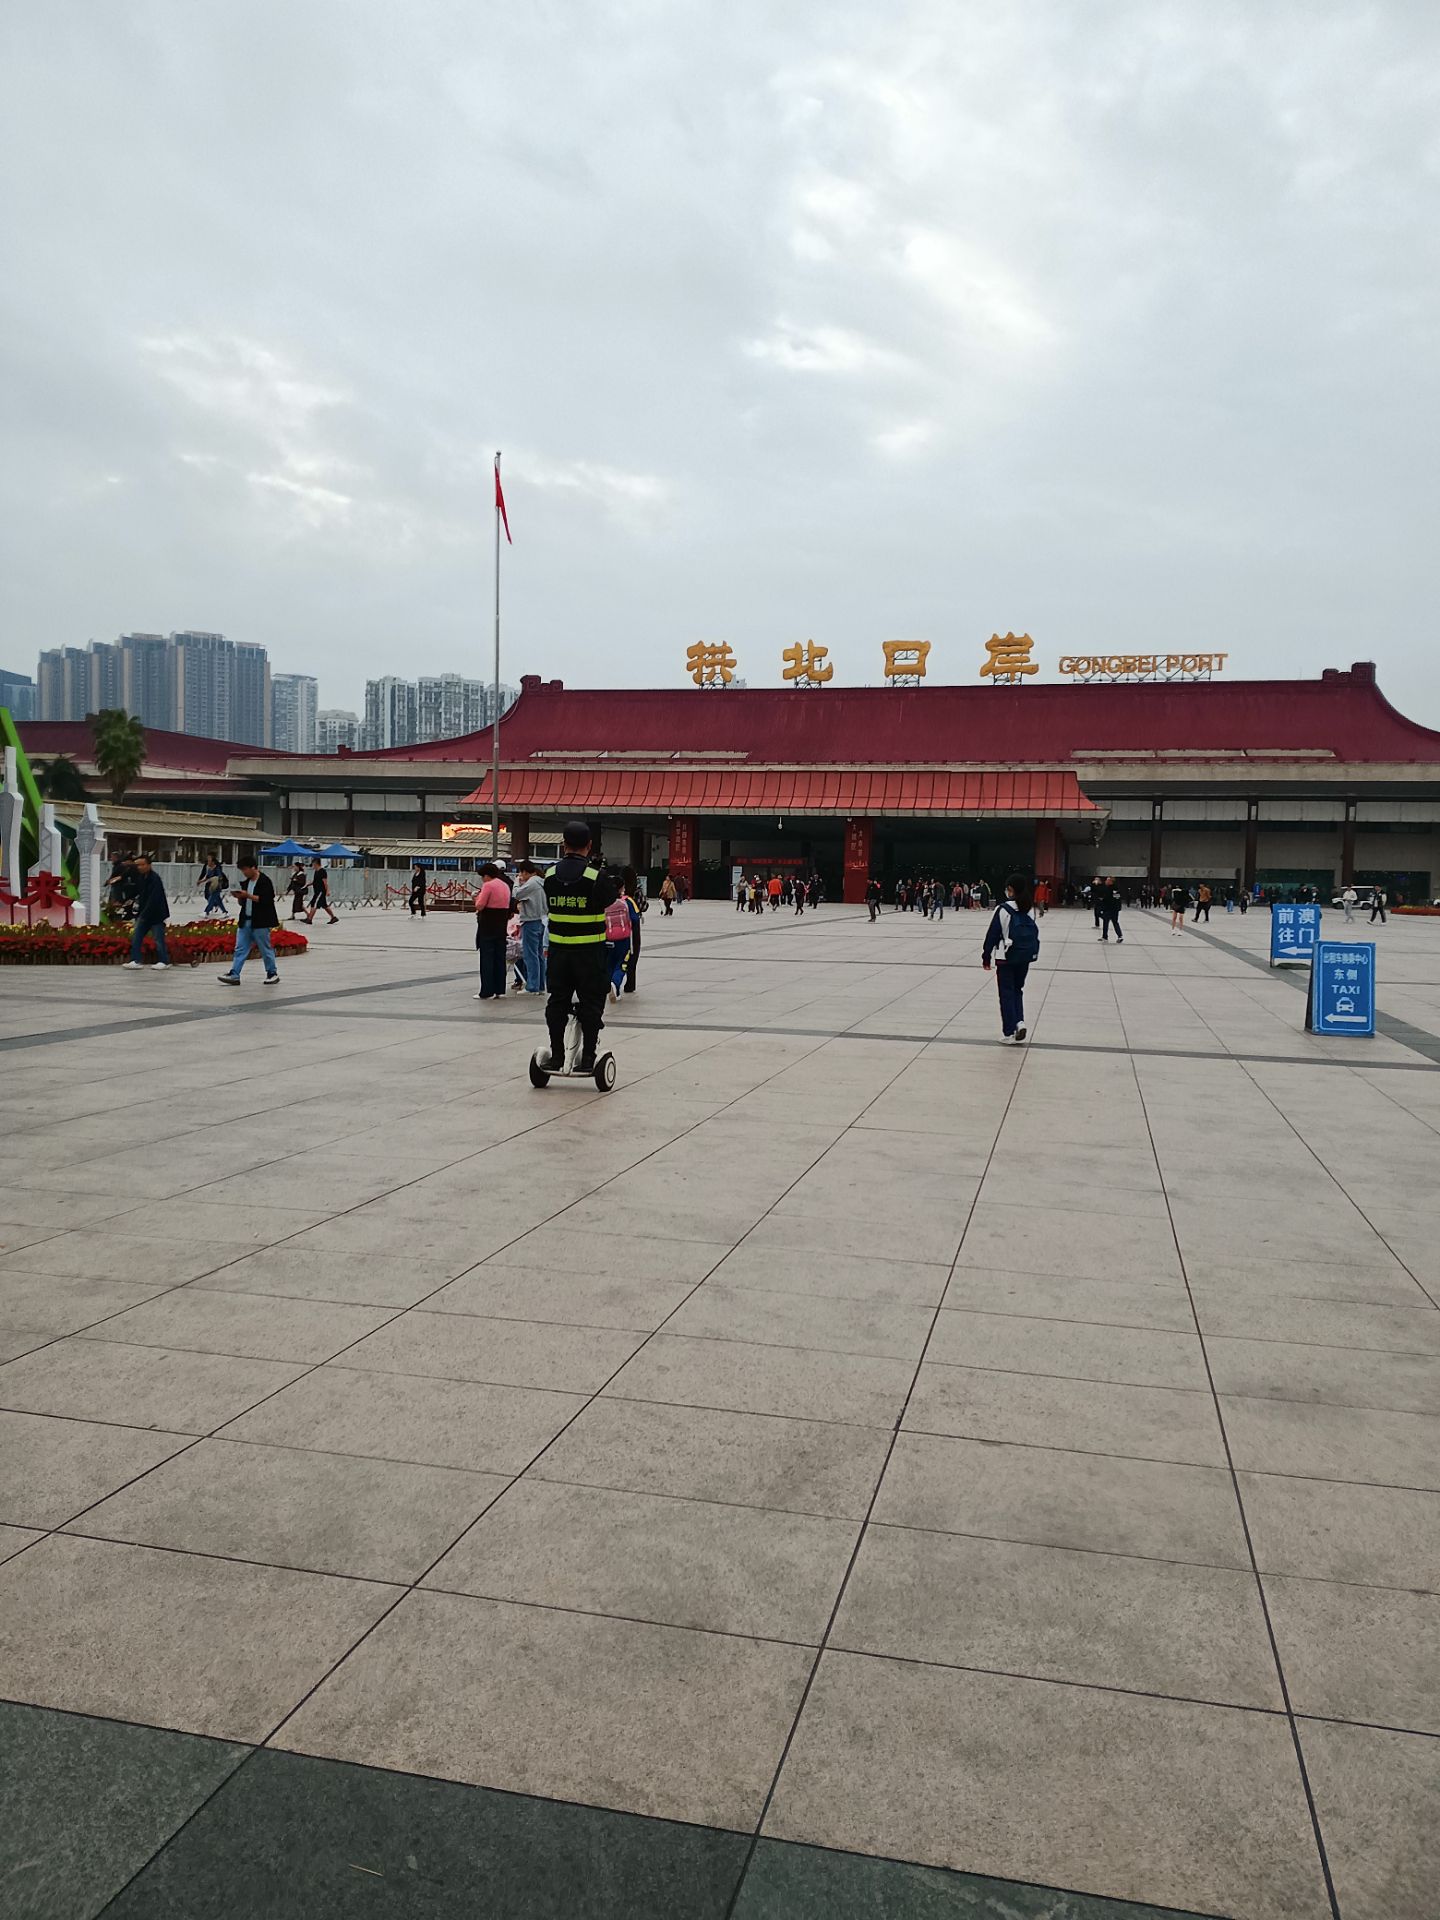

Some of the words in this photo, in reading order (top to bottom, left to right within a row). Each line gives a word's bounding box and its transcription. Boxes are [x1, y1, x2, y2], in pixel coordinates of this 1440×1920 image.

[686, 631, 1040, 684] 拱北口岸
[1058, 655, 1158, 674] GONGBEI
[1165, 653, 1228, 673] PORT
[1331, 984, 1361, 995] TAXI
